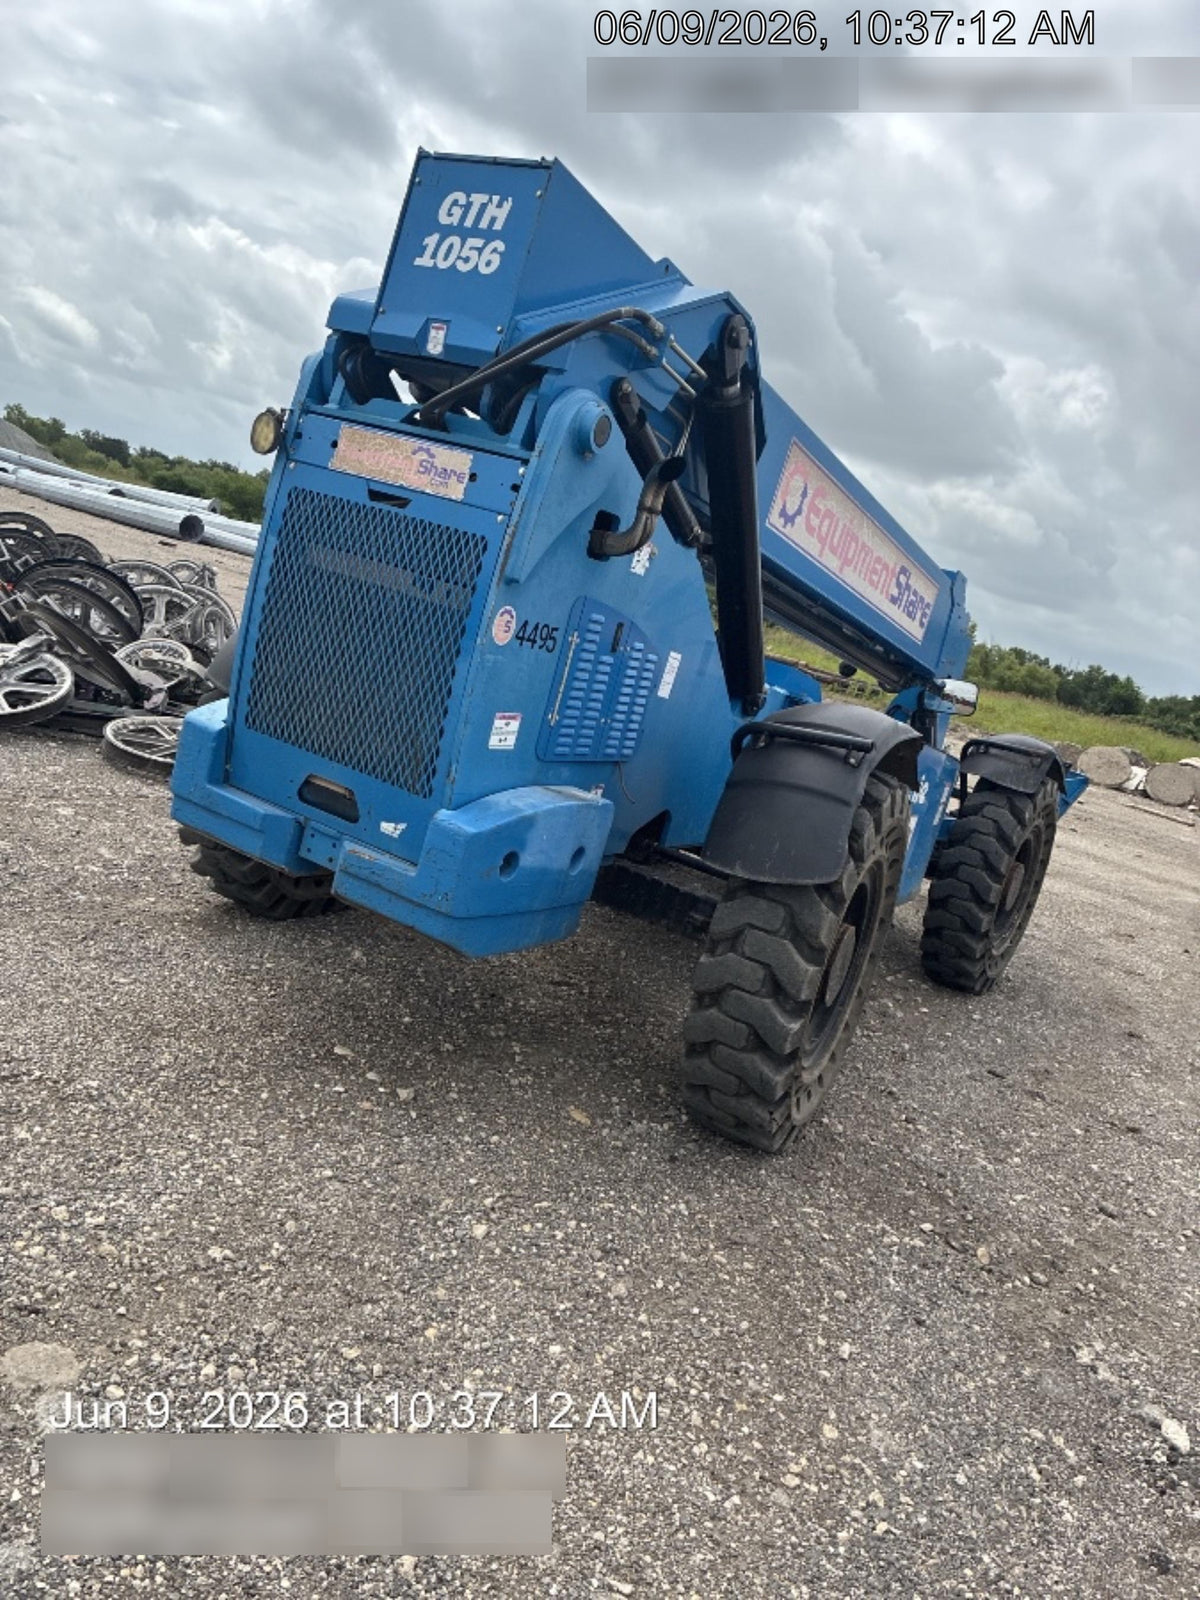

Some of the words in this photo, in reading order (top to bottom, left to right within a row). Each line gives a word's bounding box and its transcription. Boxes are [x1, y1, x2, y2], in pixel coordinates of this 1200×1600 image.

[438, 191, 513, 231] GTH
[413, 232, 506, 275] 1056
[515, 619, 560, 654] 4495
